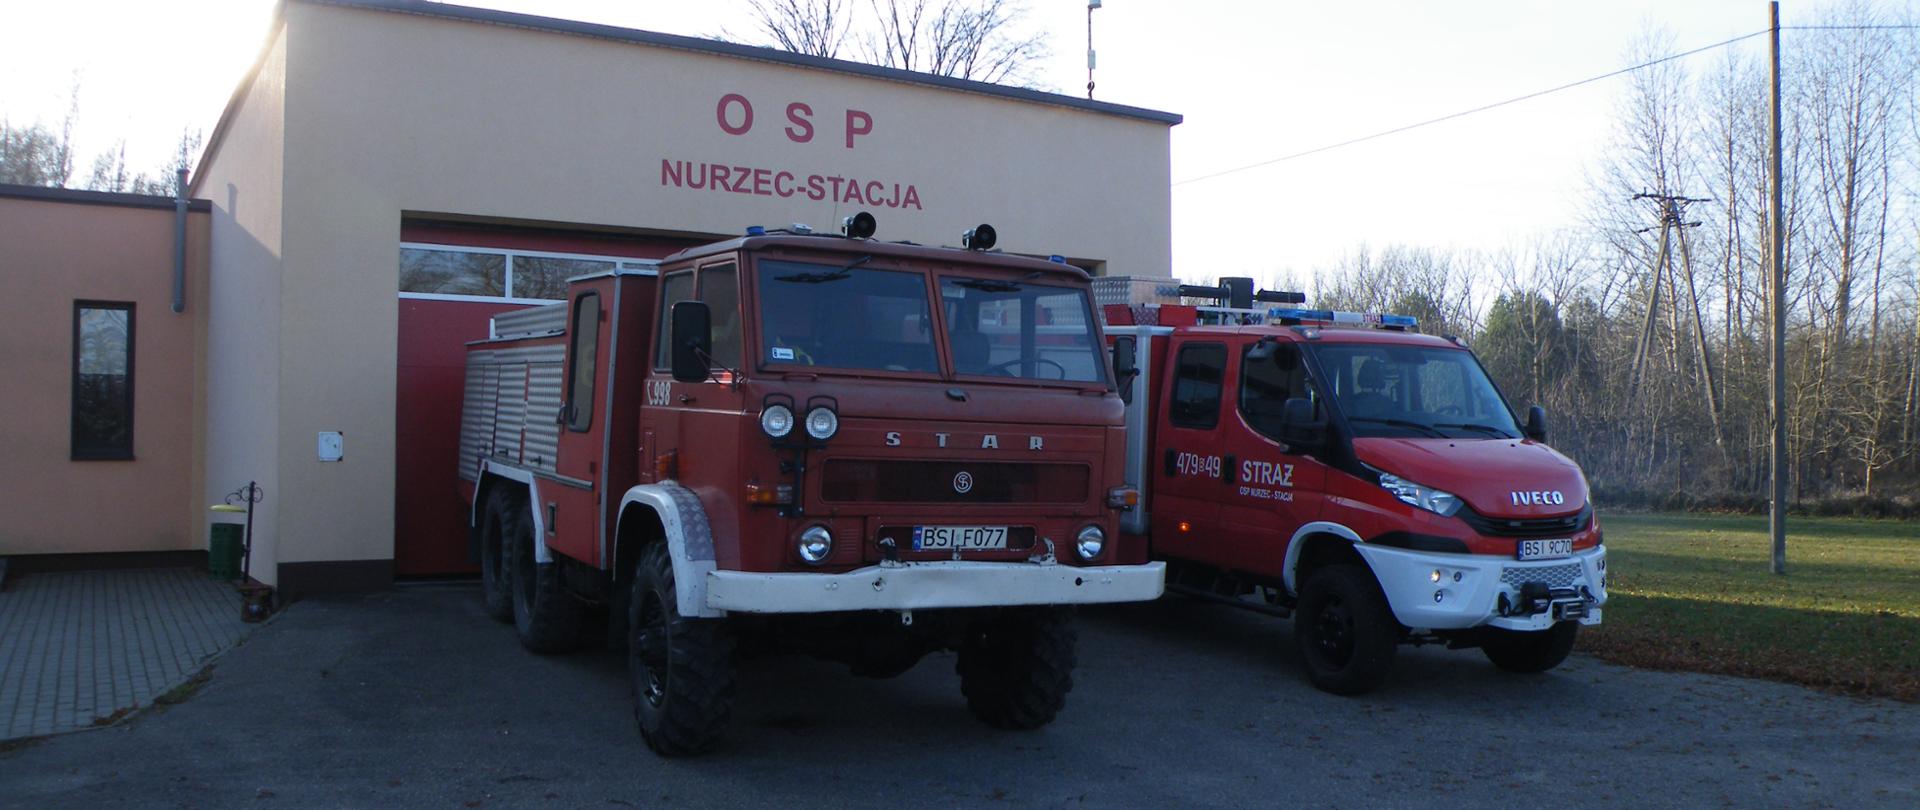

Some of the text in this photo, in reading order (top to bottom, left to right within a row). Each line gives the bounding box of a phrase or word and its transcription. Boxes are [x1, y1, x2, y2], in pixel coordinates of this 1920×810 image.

[661, 159, 922, 210] NURZEC-STACJA
[654, 381, 671, 406] 998
[886, 432, 1044, 450] STAR
[1512, 491, 1564, 505] IVECO
[963, 529, 1005, 547] F077
[1549, 540, 1571, 554] 9C70
